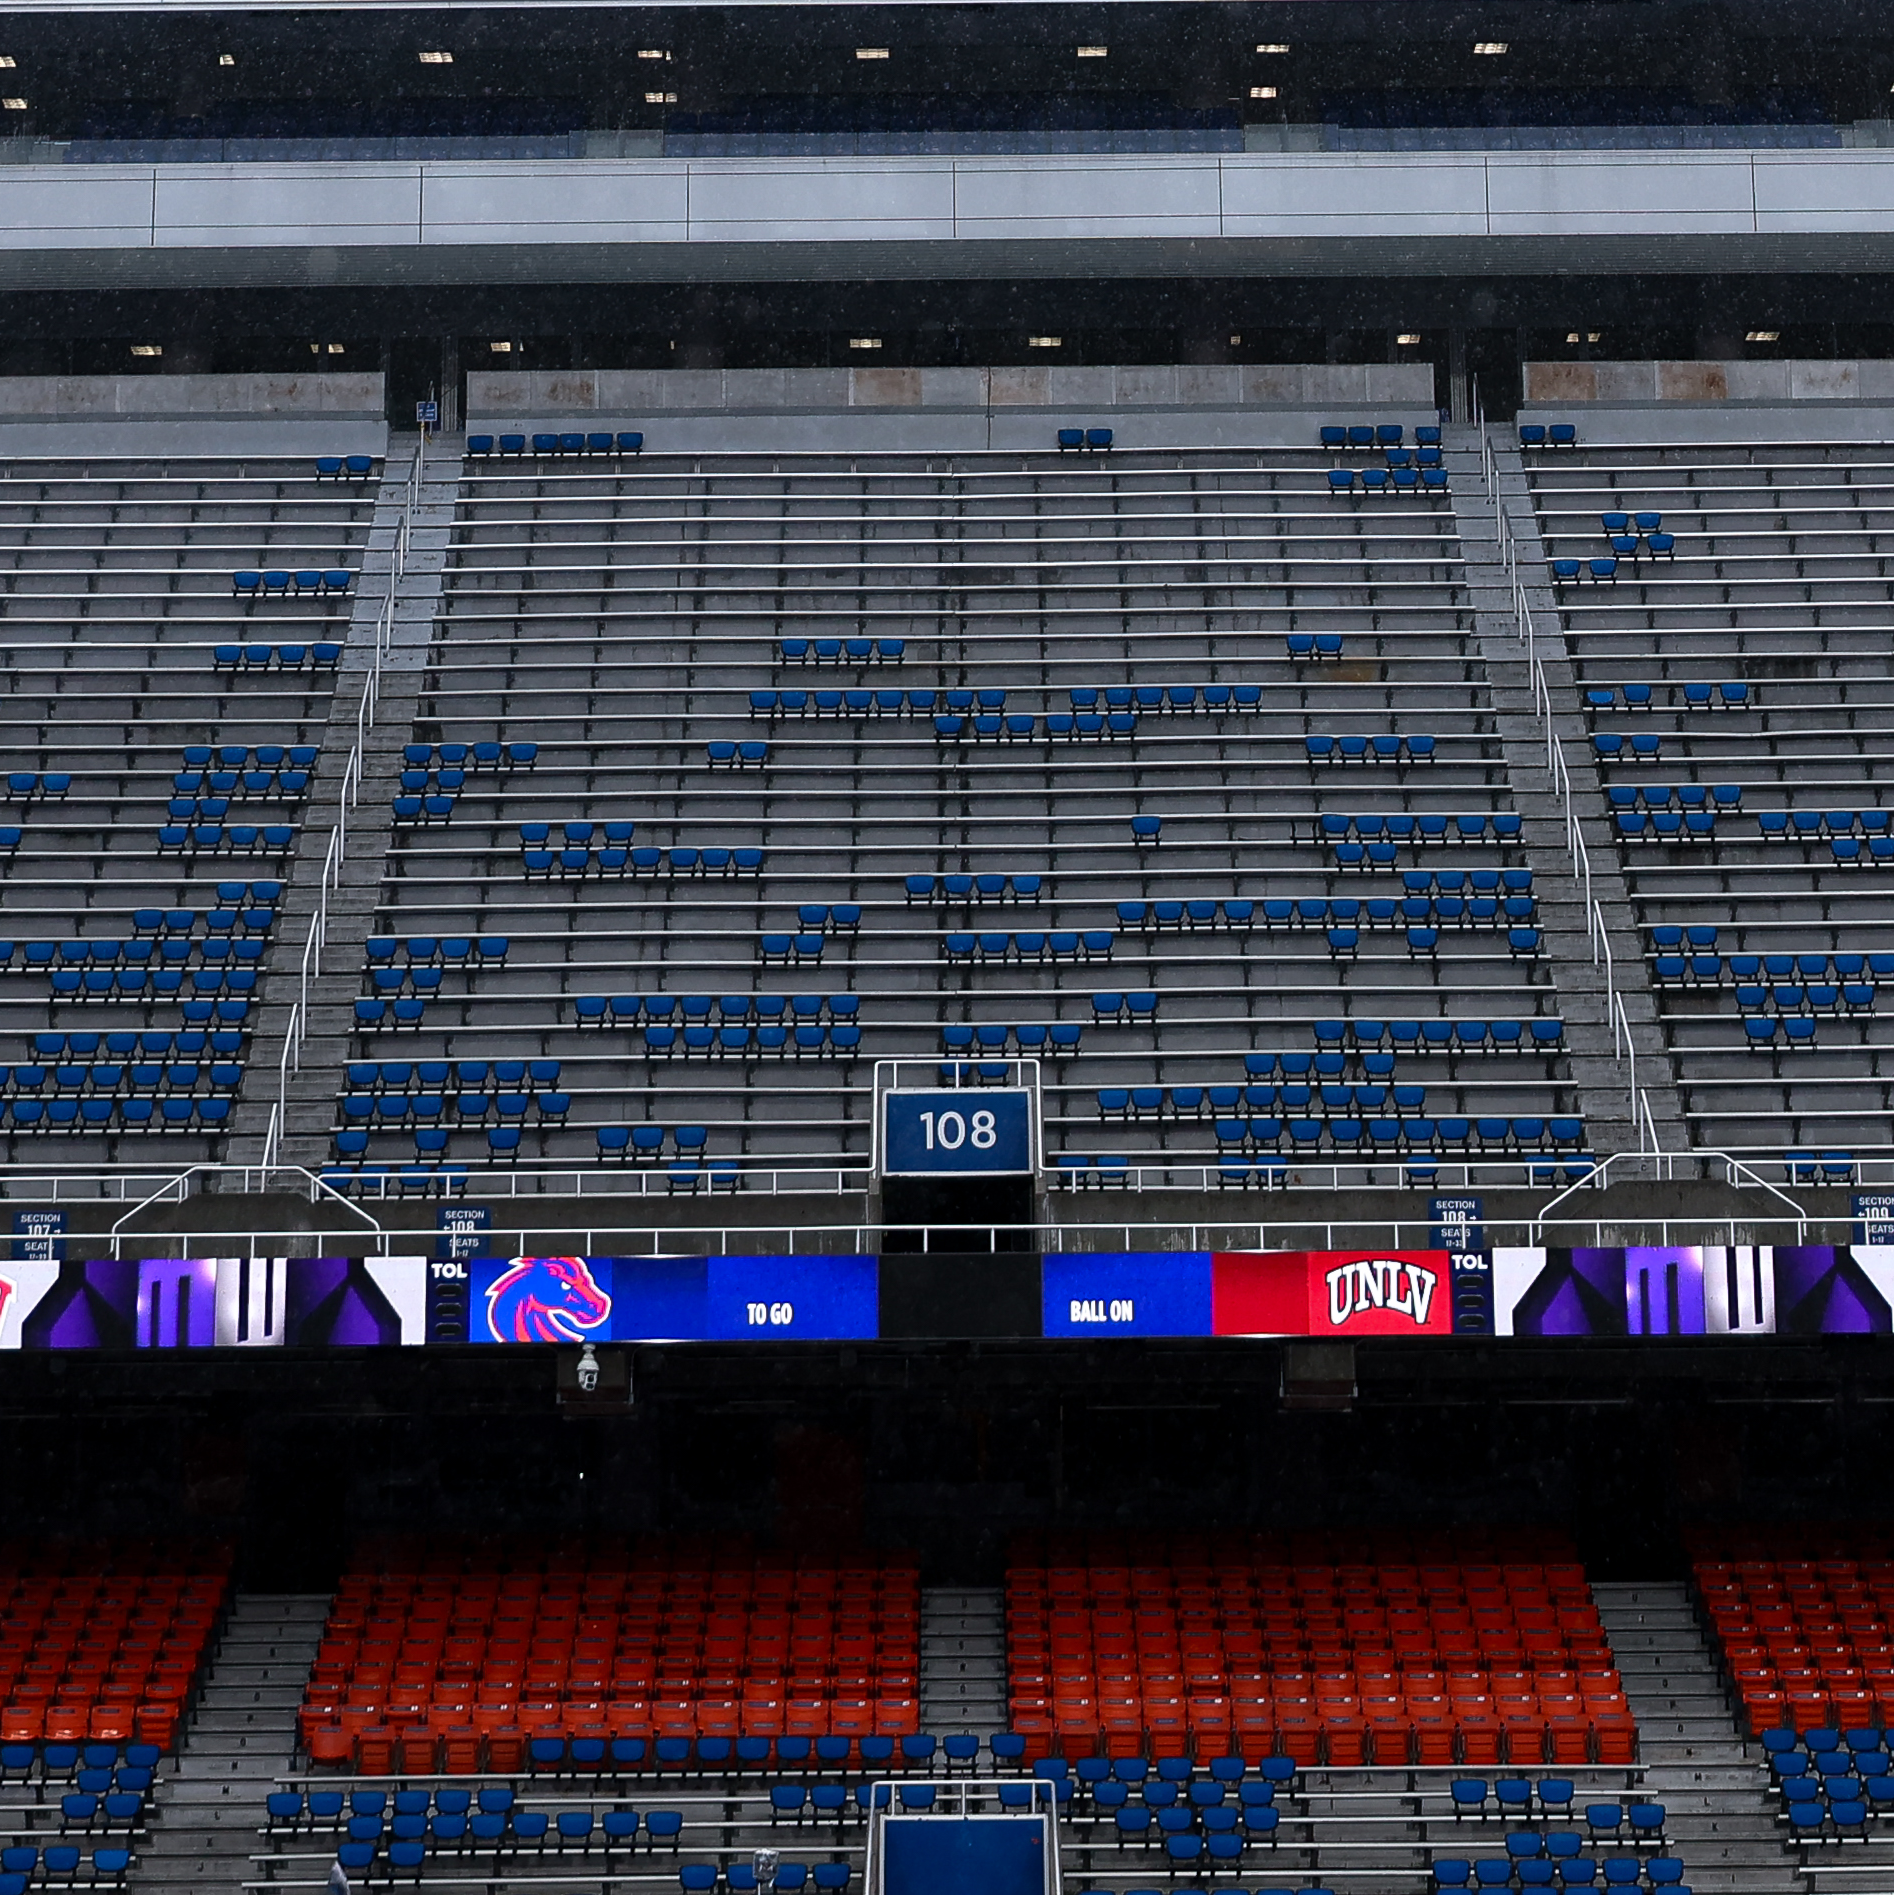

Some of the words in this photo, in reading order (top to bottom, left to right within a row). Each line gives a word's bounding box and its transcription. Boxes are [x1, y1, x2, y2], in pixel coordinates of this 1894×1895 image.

[919, 1110, 997, 1150] 108
[1436, 1200, 1476, 1209] SECTION
[20, 1214, 61, 1223] SECTION
[445, 1210, 485, 1219] SECTION
[27, 1224, 51, 1237] 107
[1451, 1254, 1489, 1270] TOL
[431, 1262, 468, 1279] TOL
[1326, 1259, 1436, 1325] UNLV
[747, 1303, 767, 1325] TO
[770, 1302, 793, 1325] GO
[1070, 1300, 1108, 1322] BALL
[1110, 1300, 1133, 1322] ON
